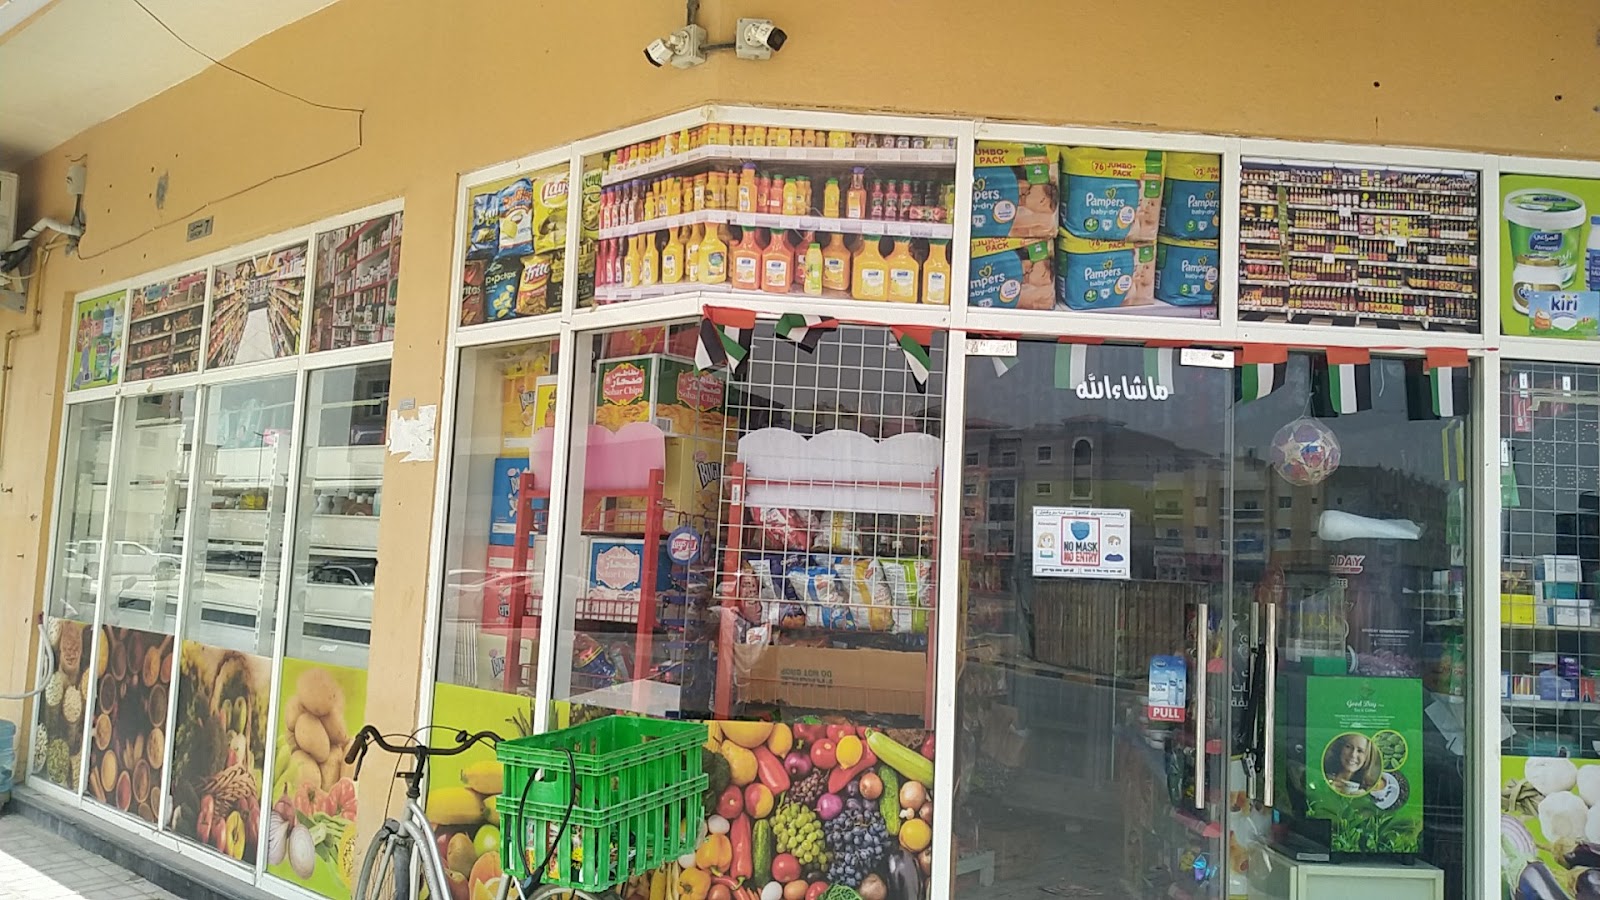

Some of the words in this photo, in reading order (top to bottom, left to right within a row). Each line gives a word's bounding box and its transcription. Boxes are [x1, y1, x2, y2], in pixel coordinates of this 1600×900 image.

[979, 156, 1006, 164] PACK
[1094, 162, 1105, 171] 76
[1107, 162, 1137, 170] JUMBO+
[1112, 169, 1132, 177] PACK
[1085, 192, 1126, 209] Pampers
[204, 218, 211, 234] 7
[985, 242, 1010, 253] PACK
[1084, 266, 1122, 281] Pampers
[1550, 294, 1578, 311] kiri
[1063, 541, 1074, 551] NO
[1075, 541, 1098, 552] MASK
[1063, 551, 1074, 562] NO
[1075, 551, 1098, 563] ENTRY
[1152, 707, 1180, 719] PULL
